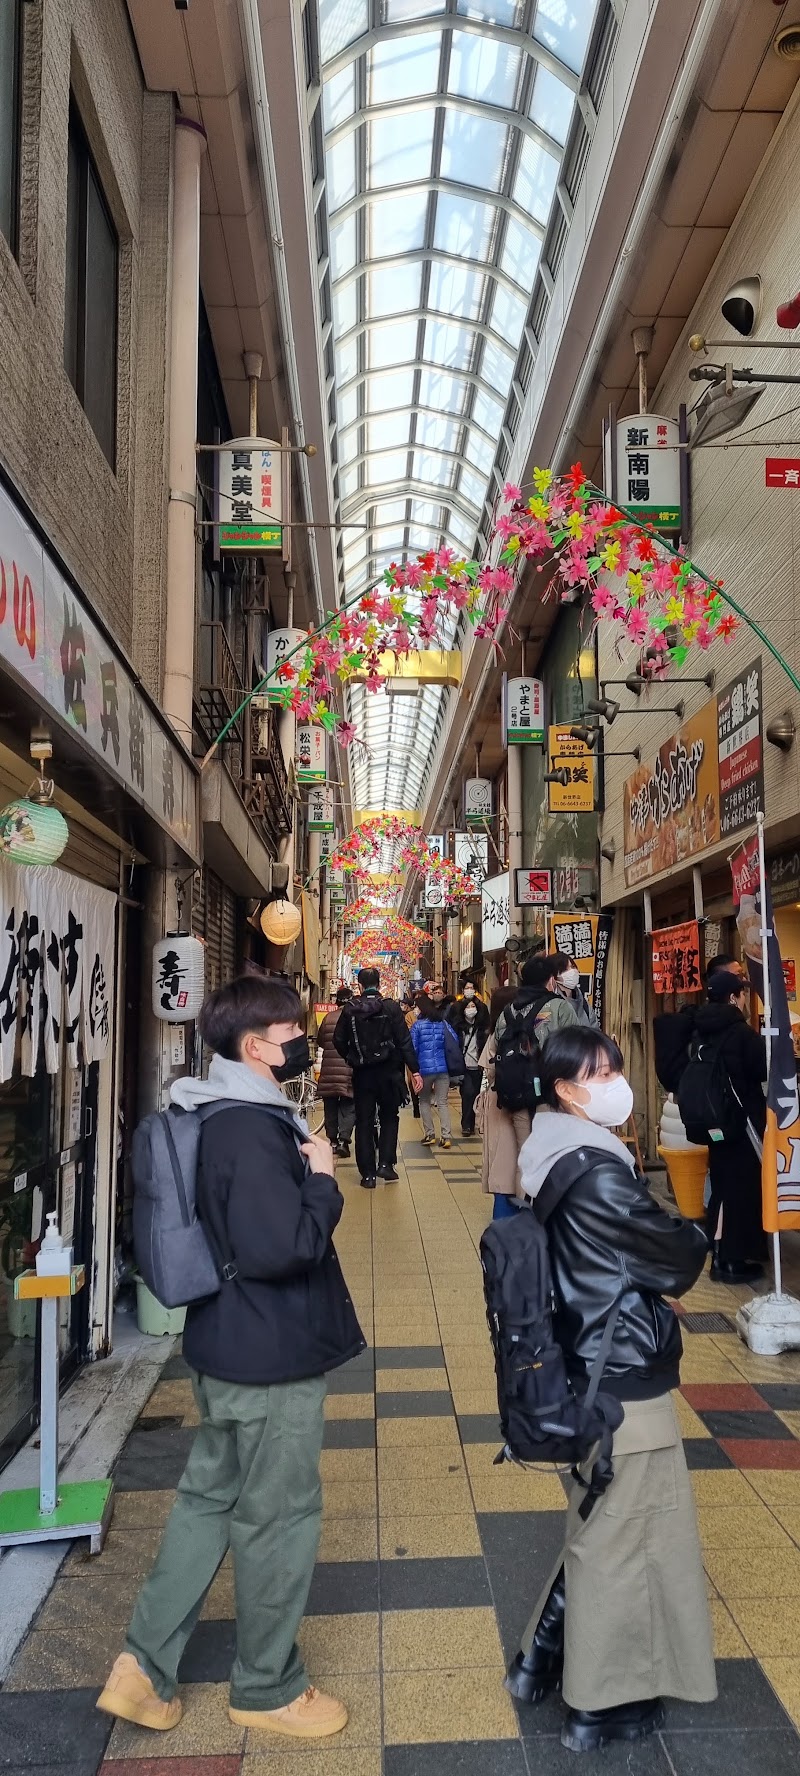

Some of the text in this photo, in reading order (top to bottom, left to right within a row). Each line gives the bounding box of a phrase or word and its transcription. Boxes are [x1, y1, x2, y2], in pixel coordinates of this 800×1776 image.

[231, 451, 252, 522] 真美堂
[627, 428, 649, 501] 新南陽
[519, 684, 531, 727] やまと屋
[731, 766, 742, 784] fried
[742, 757, 759, 777] chicken
[573, 922, 593, 958] 満腹
[155, 950, 189, 1010] 寿し
